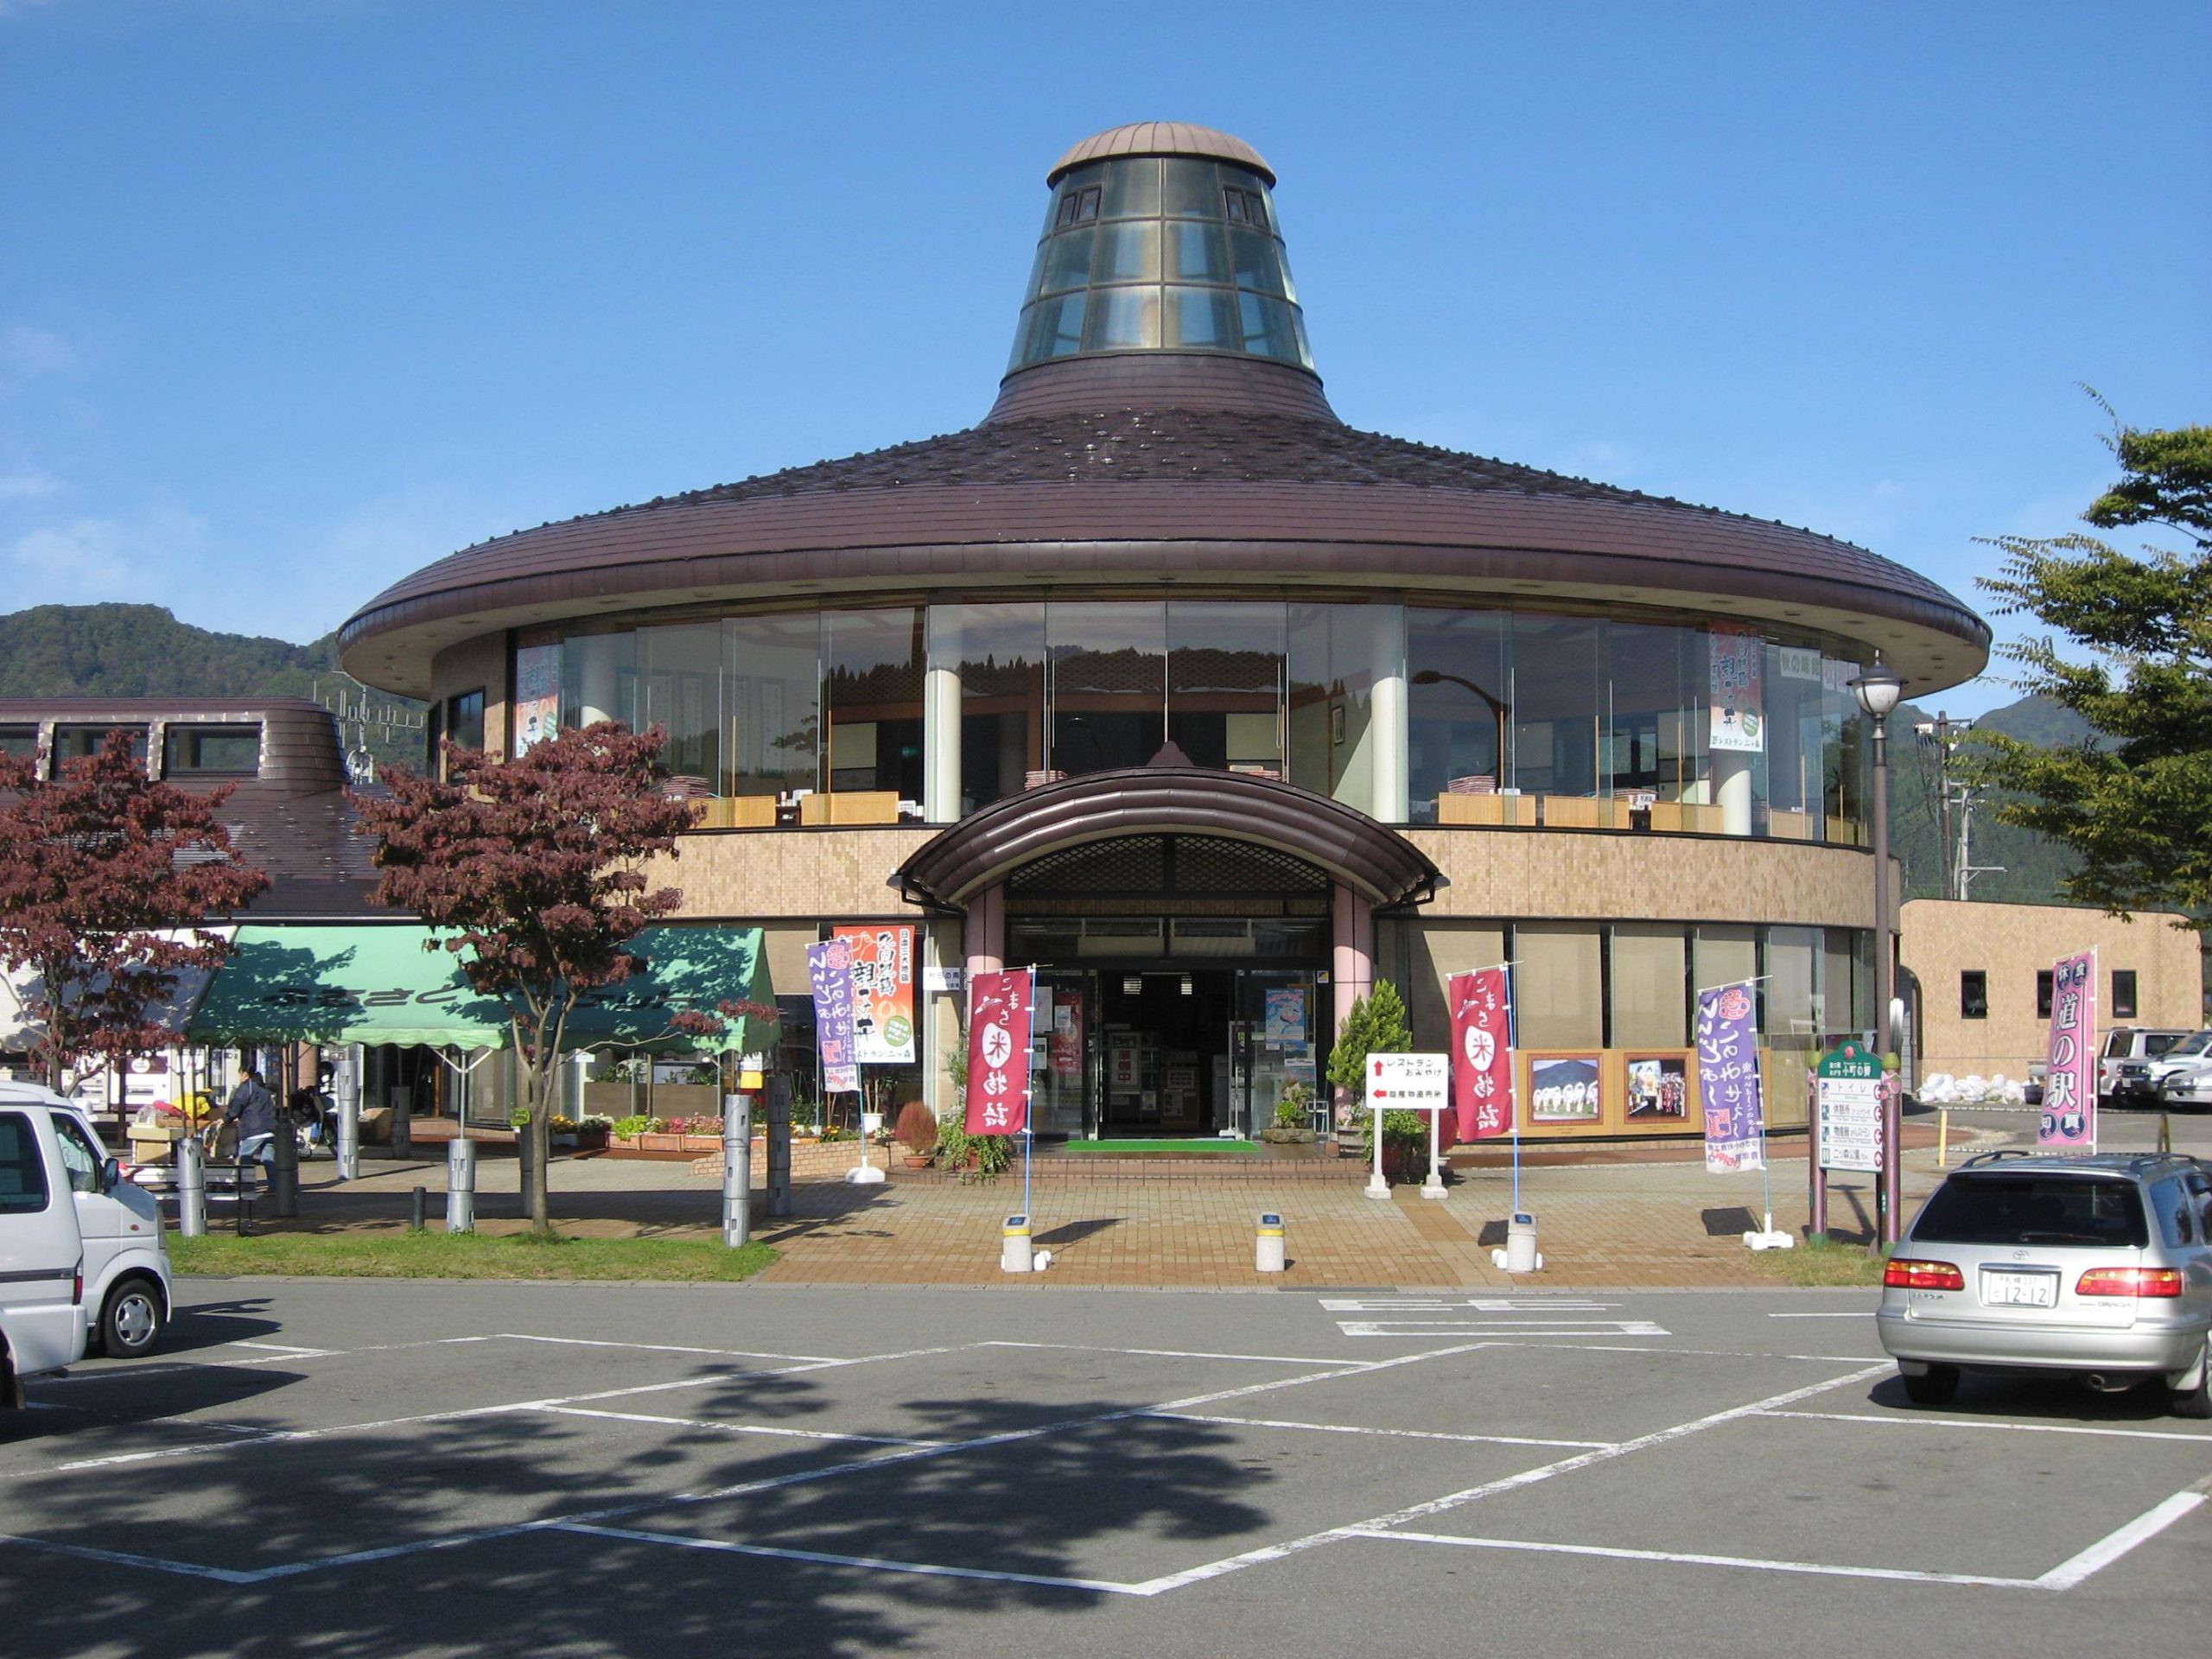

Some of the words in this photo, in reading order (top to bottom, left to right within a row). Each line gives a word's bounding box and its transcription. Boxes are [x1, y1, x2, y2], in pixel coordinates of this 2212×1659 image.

[2046, 992, 2078, 1109] 道の駅
[1838, 1083, 1867, 1093] トイレ
